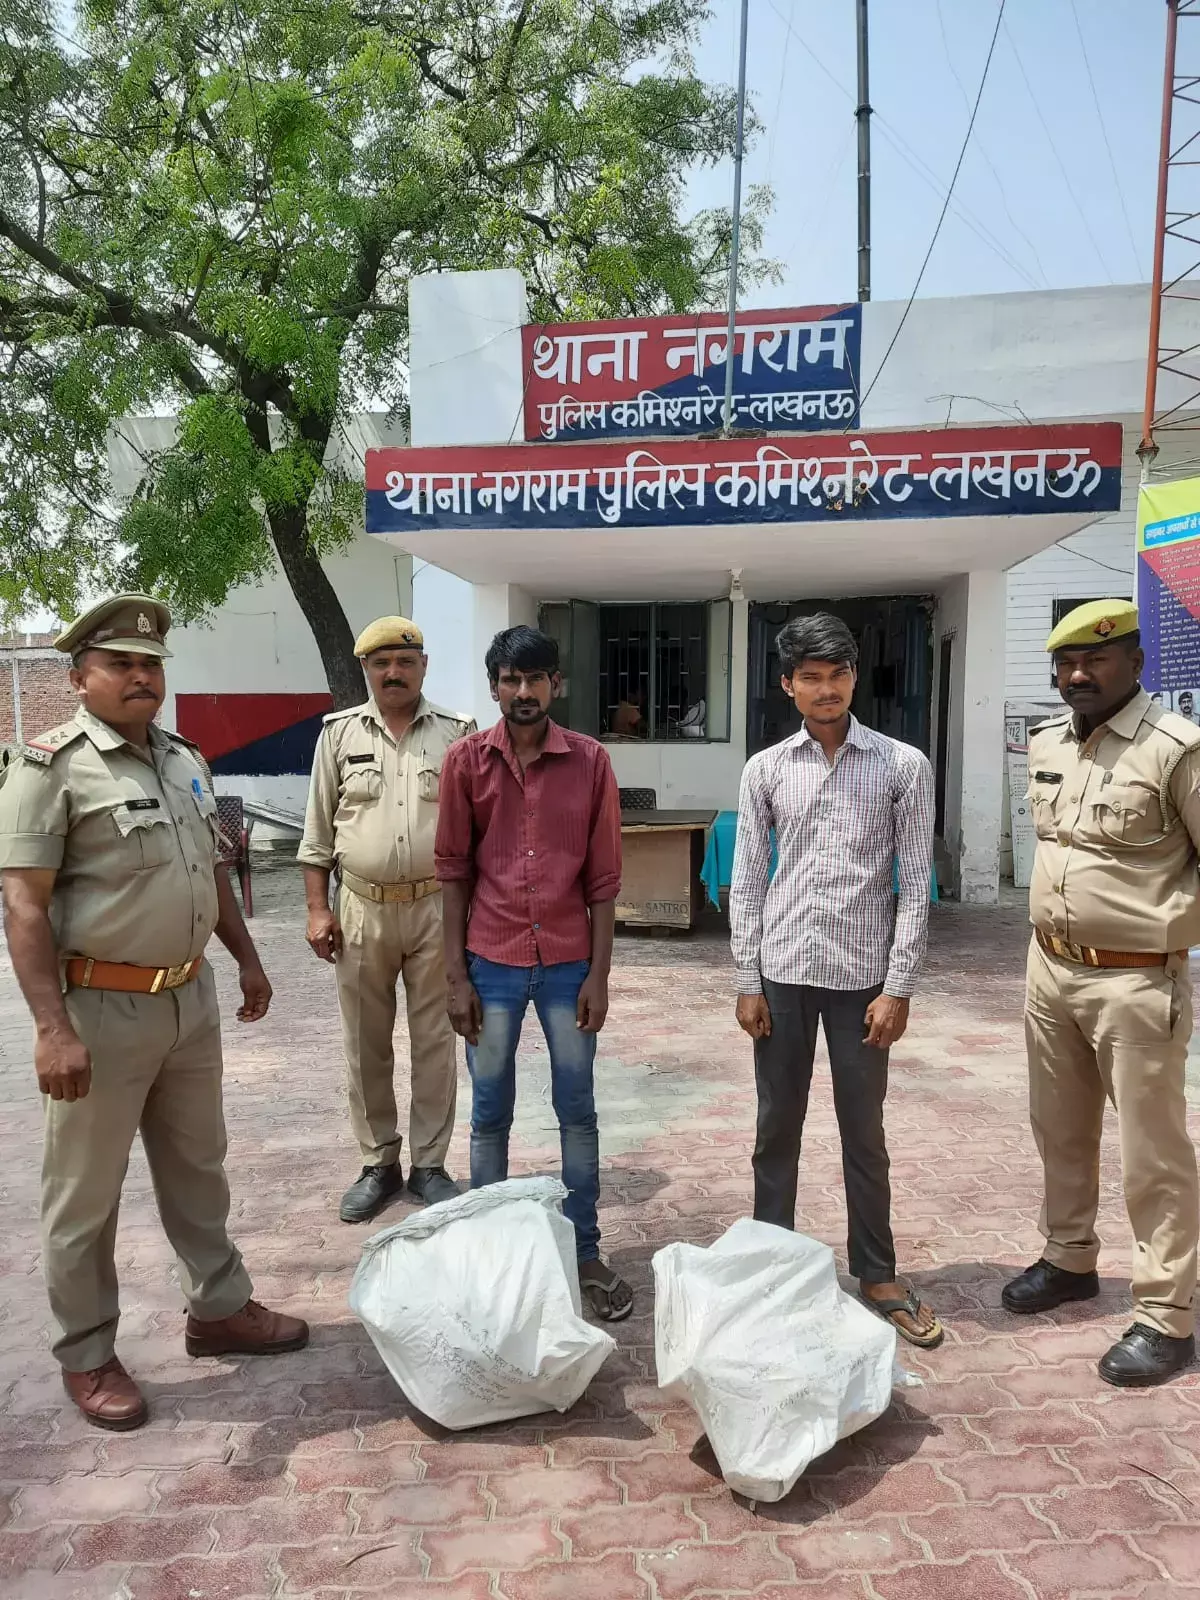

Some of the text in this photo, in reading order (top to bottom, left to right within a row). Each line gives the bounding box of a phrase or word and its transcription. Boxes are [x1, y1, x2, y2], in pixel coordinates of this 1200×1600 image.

[533, 319, 854, 385] थाना नगराम
[537, 394, 611, 440] पुलिस
[385, 470, 477, 515] थाना
[477, 468, 591, 514] नगराम
[592, 450, 711, 523] पुलिस
